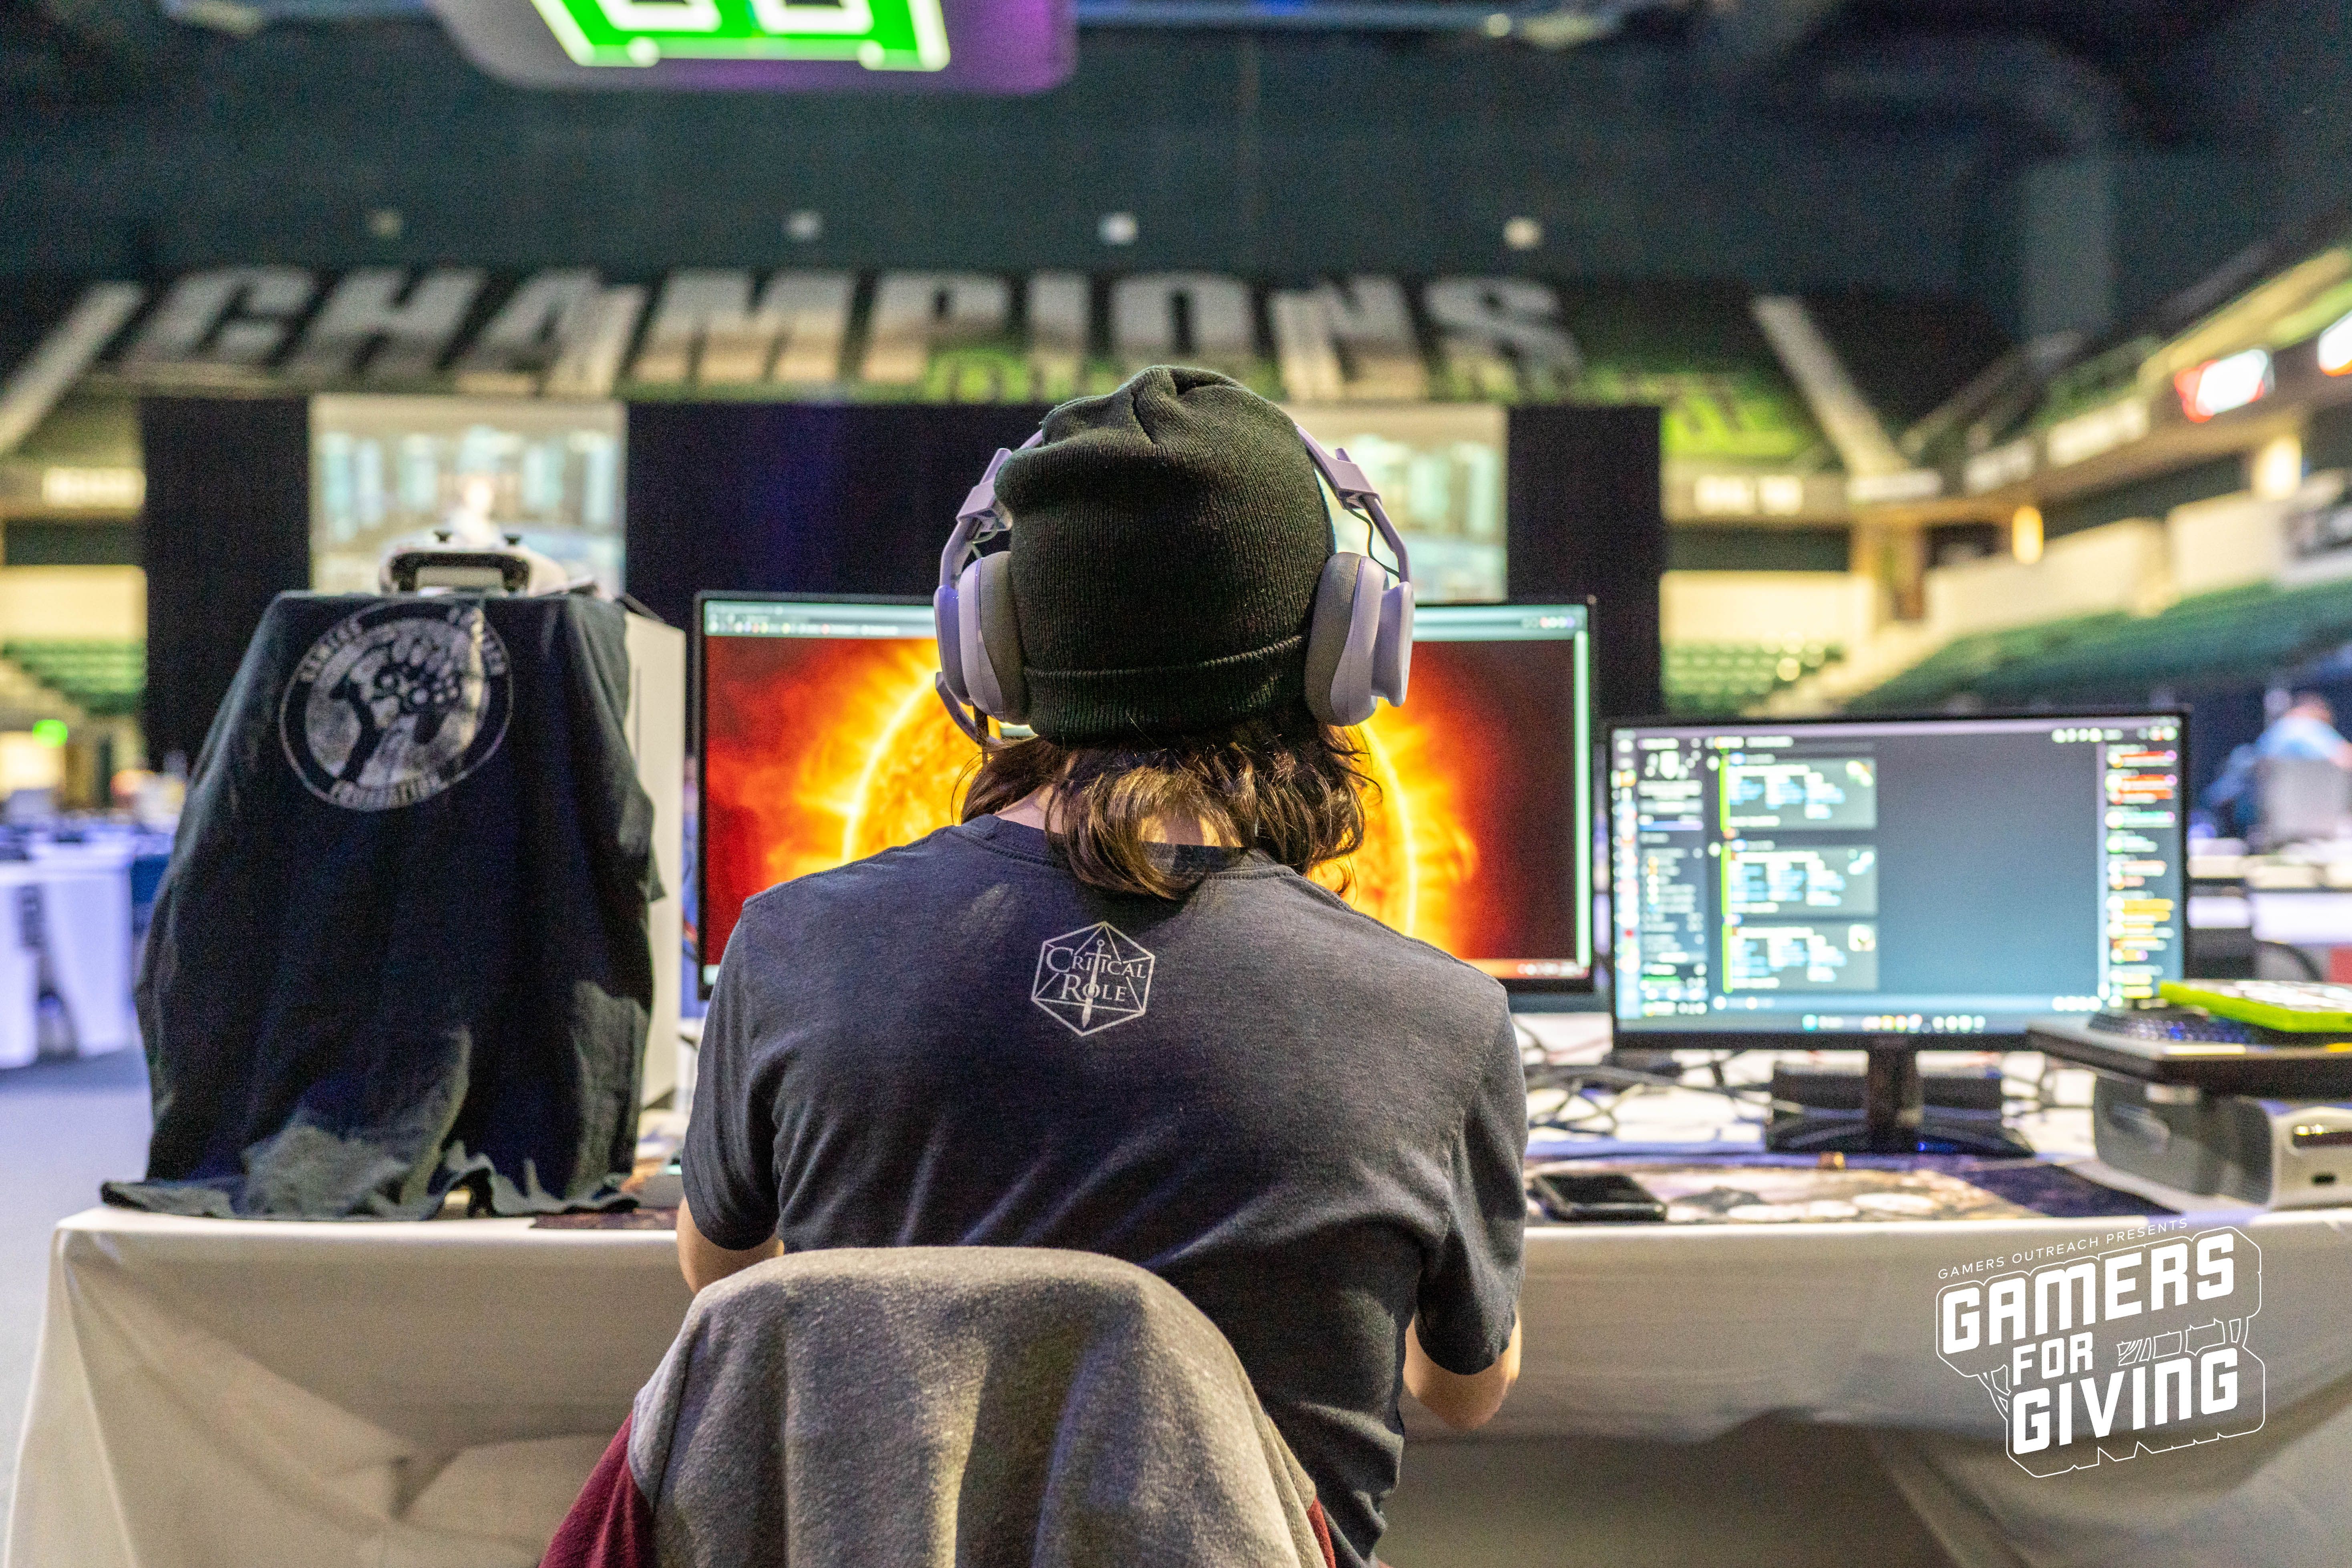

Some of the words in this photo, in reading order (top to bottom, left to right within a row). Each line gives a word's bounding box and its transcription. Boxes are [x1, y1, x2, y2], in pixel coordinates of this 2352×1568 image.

[120, 265, 1586, 399] CHAMPIONS
[1046, 946, 1147, 978] CRITICAL
[1059, 974, 1127, 1002] ROLE
